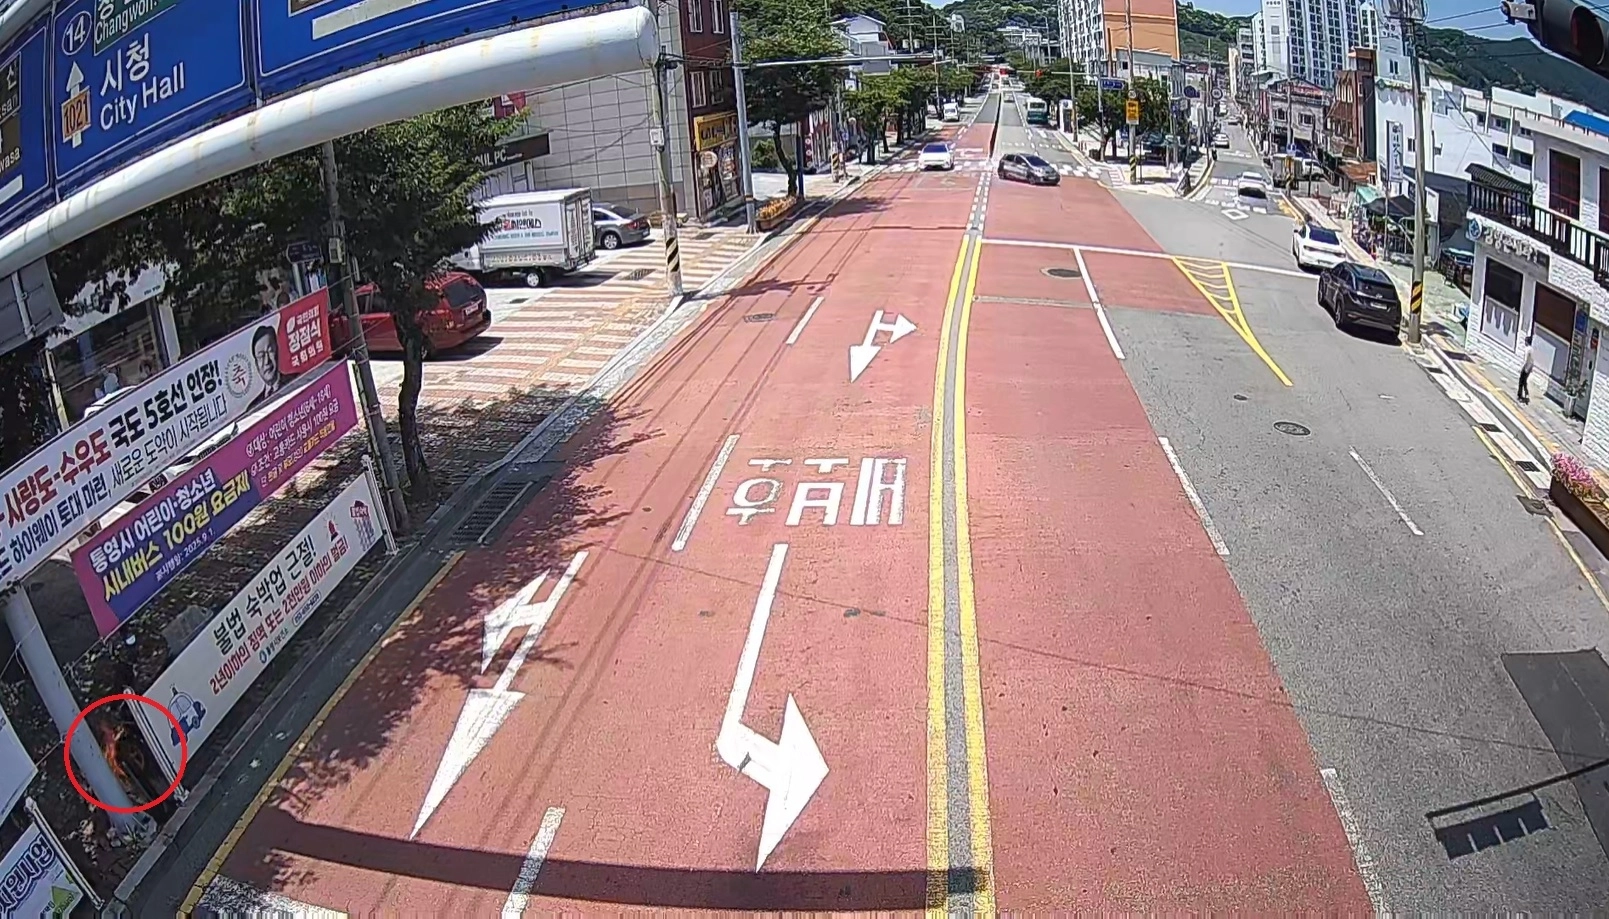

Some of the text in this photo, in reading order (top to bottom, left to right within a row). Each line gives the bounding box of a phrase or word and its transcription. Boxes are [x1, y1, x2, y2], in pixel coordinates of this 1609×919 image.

[66, 16, 86, 51] 14
[100, 33, 149, 96] 시청
[0, 93, 18, 117] san
[64, 91, 90, 133] 1021
[100, 62, 185, 130] City Hall
[287, 317, 322, 354] 정점식
[291, 339, 324, 367] 국회의원
[108, 406, 146, 449] 국도
[143, 379, 188, 430] 5호선
[10, 508, 60, 564] 하이웨이
[56, 497, 84, 528] 토대
[82, 472, 112, 511] 마련,
[111, 448, 145, 489] 새로운
[144, 425, 178, 466] 도약이
[180, 393, 228, 442] 시작됩니다
[89, 527, 135, 574] 통영시
[101, 539, 164, 602] 시내버스
[162, 503, 211, 551] 100원
[210, 469, 251, 517] 요금제
[209, 641, 251, 695] 2년이하의
[248, 624, 269, 653] 징역
[265, 606, 285, 633] 또는
[281, 575, 311, 613] 2천만원
[309, 552, 333, 585] 이하의
[213, 607, 248, 657] 불법
[245, 564, 288, 619] 숙박업
[285, 534, 317, 581] 근절!
